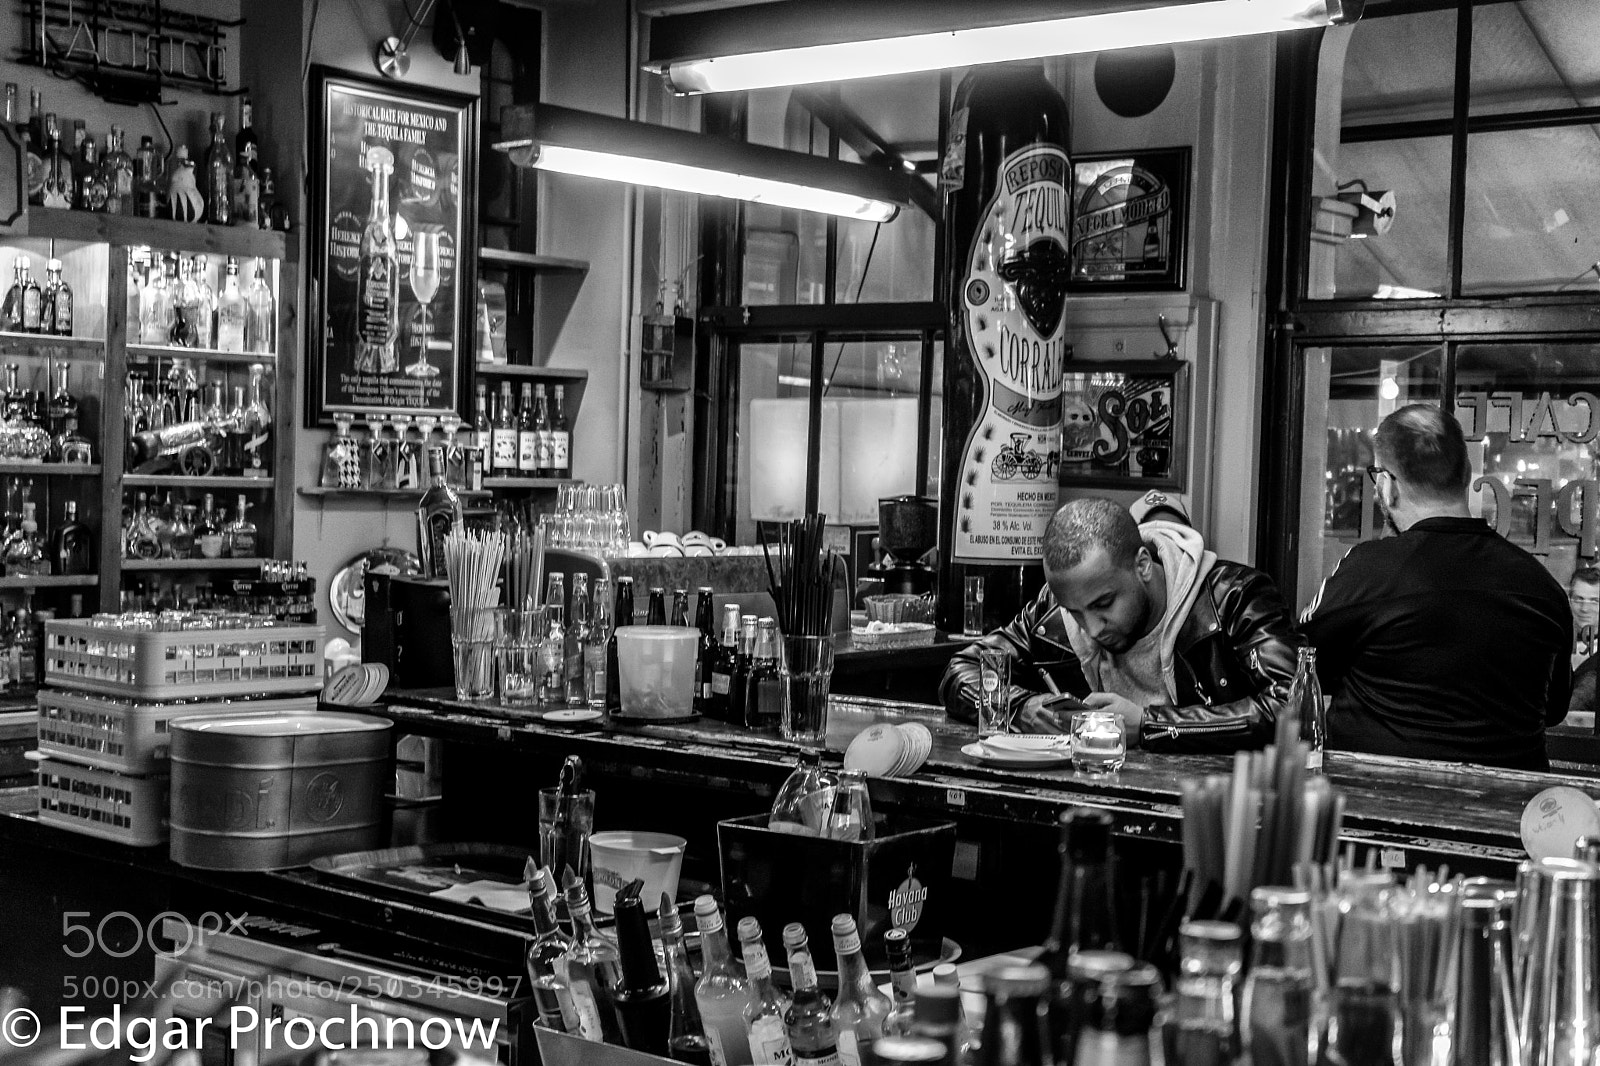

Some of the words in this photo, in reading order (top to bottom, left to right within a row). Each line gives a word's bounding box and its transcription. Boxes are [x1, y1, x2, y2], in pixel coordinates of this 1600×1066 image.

[343, 101, 381, 121] HISTORICAL
[381, 107, 396, 124] DATE
[397, 110, 410, 126] FOR
[410, 112, 434, 130] MEXICO
[434, 118, 447, 132] AND
[364, 121, 377, 136] THE
[377, 123, 404, 143] TEQUILA
[403, 128, 427, 145] FAMILY
[1017, 491, 1036, 501] HECHO
[1036, 491, 1044, 501] EN
[992, 520, 1001, 531] 38
[975, 534, 989, 544] ABUSO
[1001, 535, 1021, 545] CONSUMO
[1027, 536, 1037, 545] ESTE
[1011, 546, 1026, 555] EVITA
[1026, 546, 1033, 555] EL
[888, 886, 928, 910] Havana
[895, 904, 918, 926] Club
